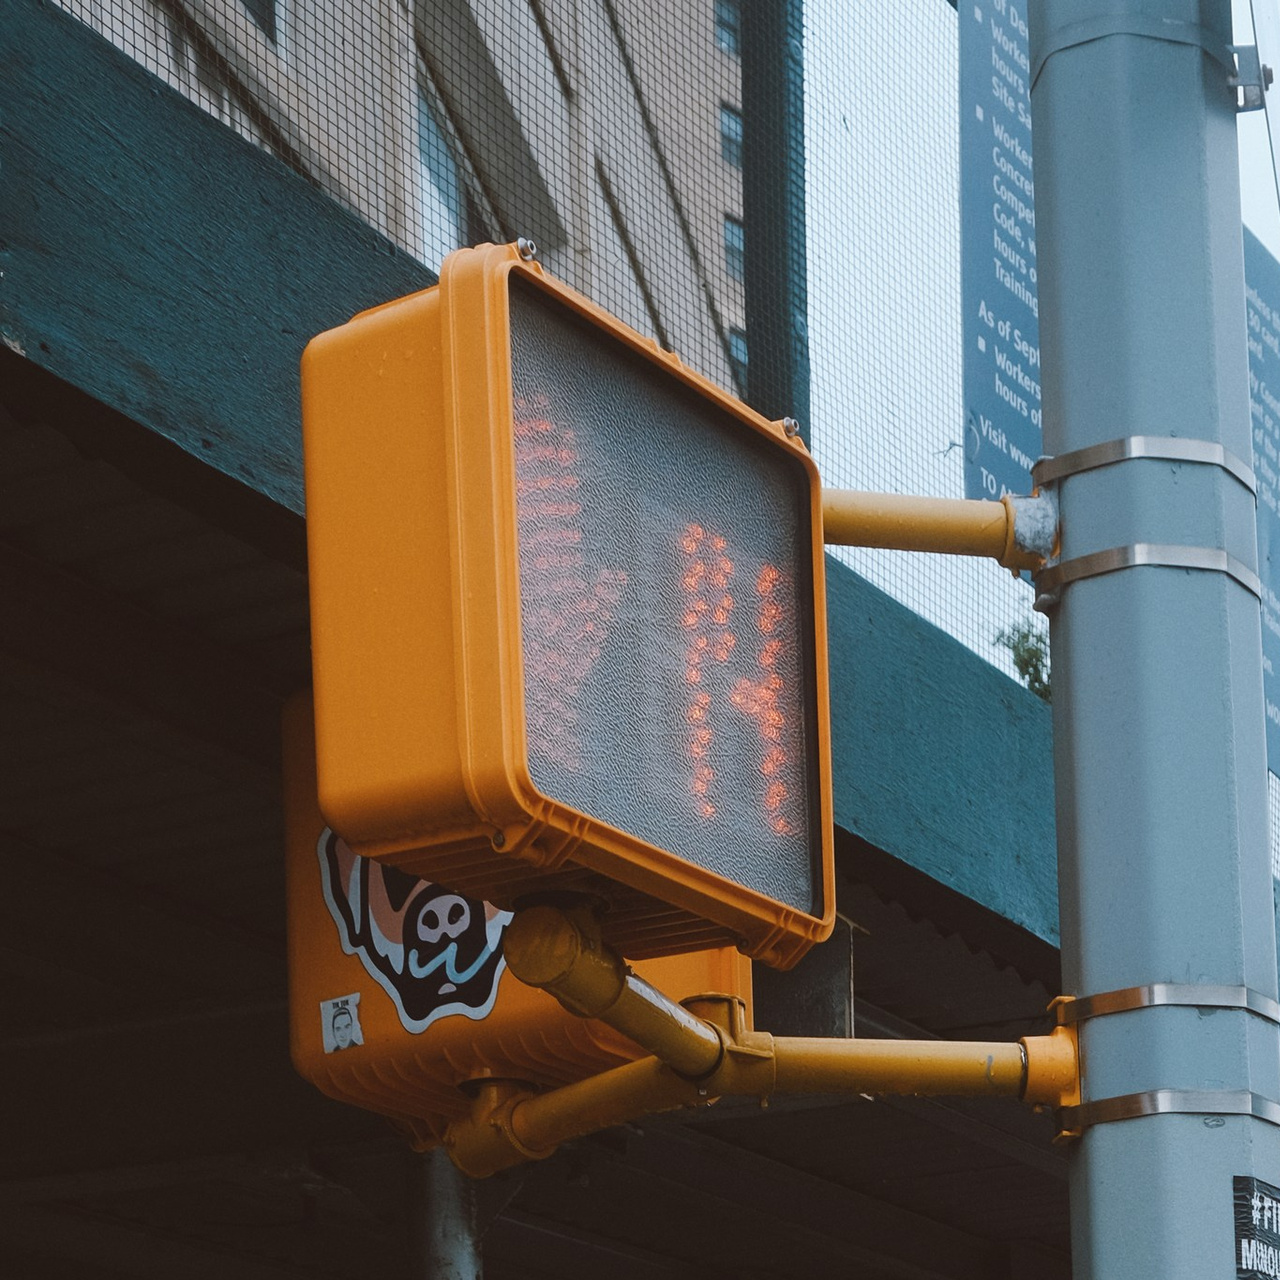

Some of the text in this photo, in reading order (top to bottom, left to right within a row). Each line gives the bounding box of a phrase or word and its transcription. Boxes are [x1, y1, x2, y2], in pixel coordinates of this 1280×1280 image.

[991, 17, 1030, 74] Worke
[1010, 5, 1029, 41] De
[992, 46, 1024, 95] hours
[992, 76, 1015, 113] Site
[993, 147, 1035, 200] Concre
[993, 175, 1036, 229] Compe
[993, 203, 1025, 248] Code,
[994, 229, 1027, 275] hours
[978, 300, 994, 328] As
[998, 320, 1011, 342] of
[994, 345, 1042, 400] Workers
[995, 373, 1028, 417] hours
[980, 415, 1008, 455] Visit
[981, 467, 997, 495] TO
